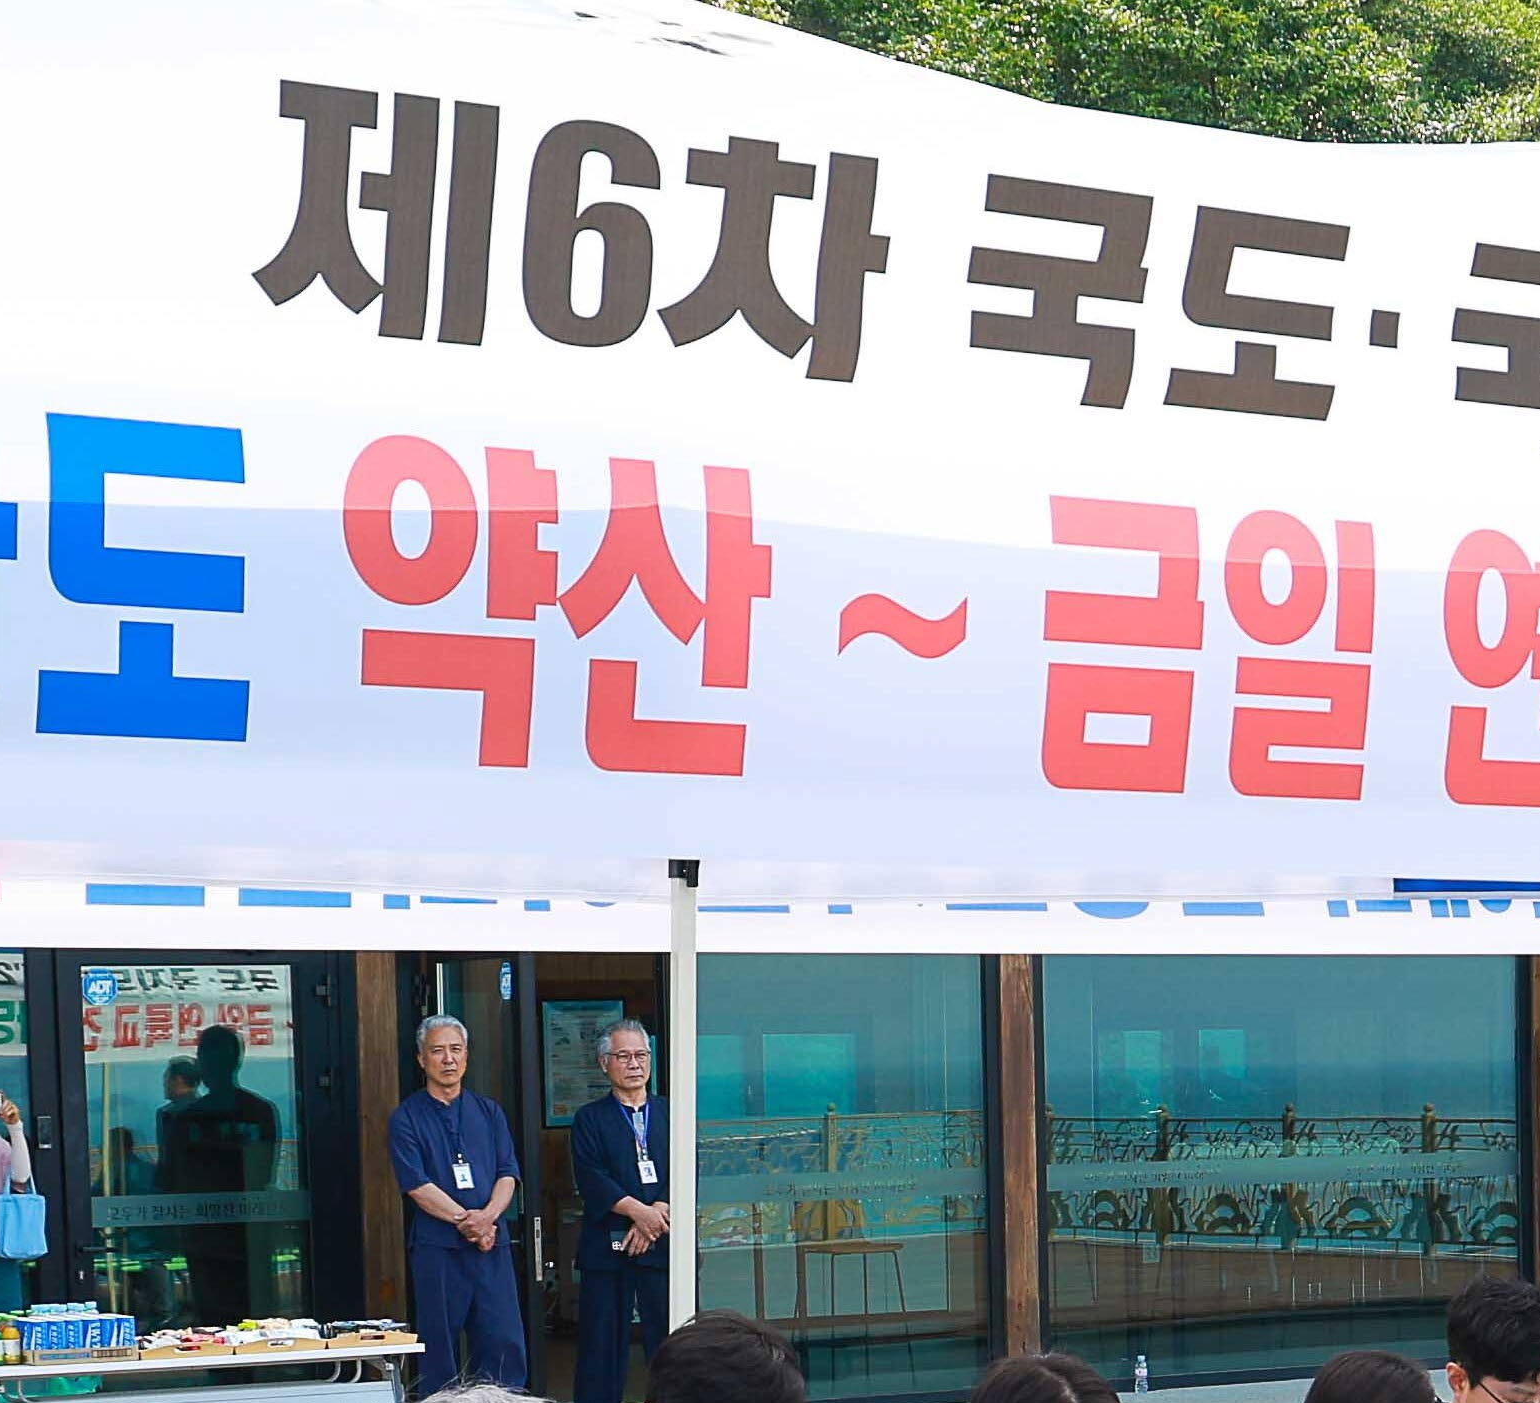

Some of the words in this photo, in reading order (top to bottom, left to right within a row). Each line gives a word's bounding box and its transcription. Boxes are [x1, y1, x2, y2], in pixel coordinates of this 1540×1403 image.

[252, 78, 891, 383] 제6차
[341, 434, 773, 778] 약산
[837, 592, 968, 660] ~
[1041, 494, 1375, 802] 금일
[87, 981, 114, 996] ADT
